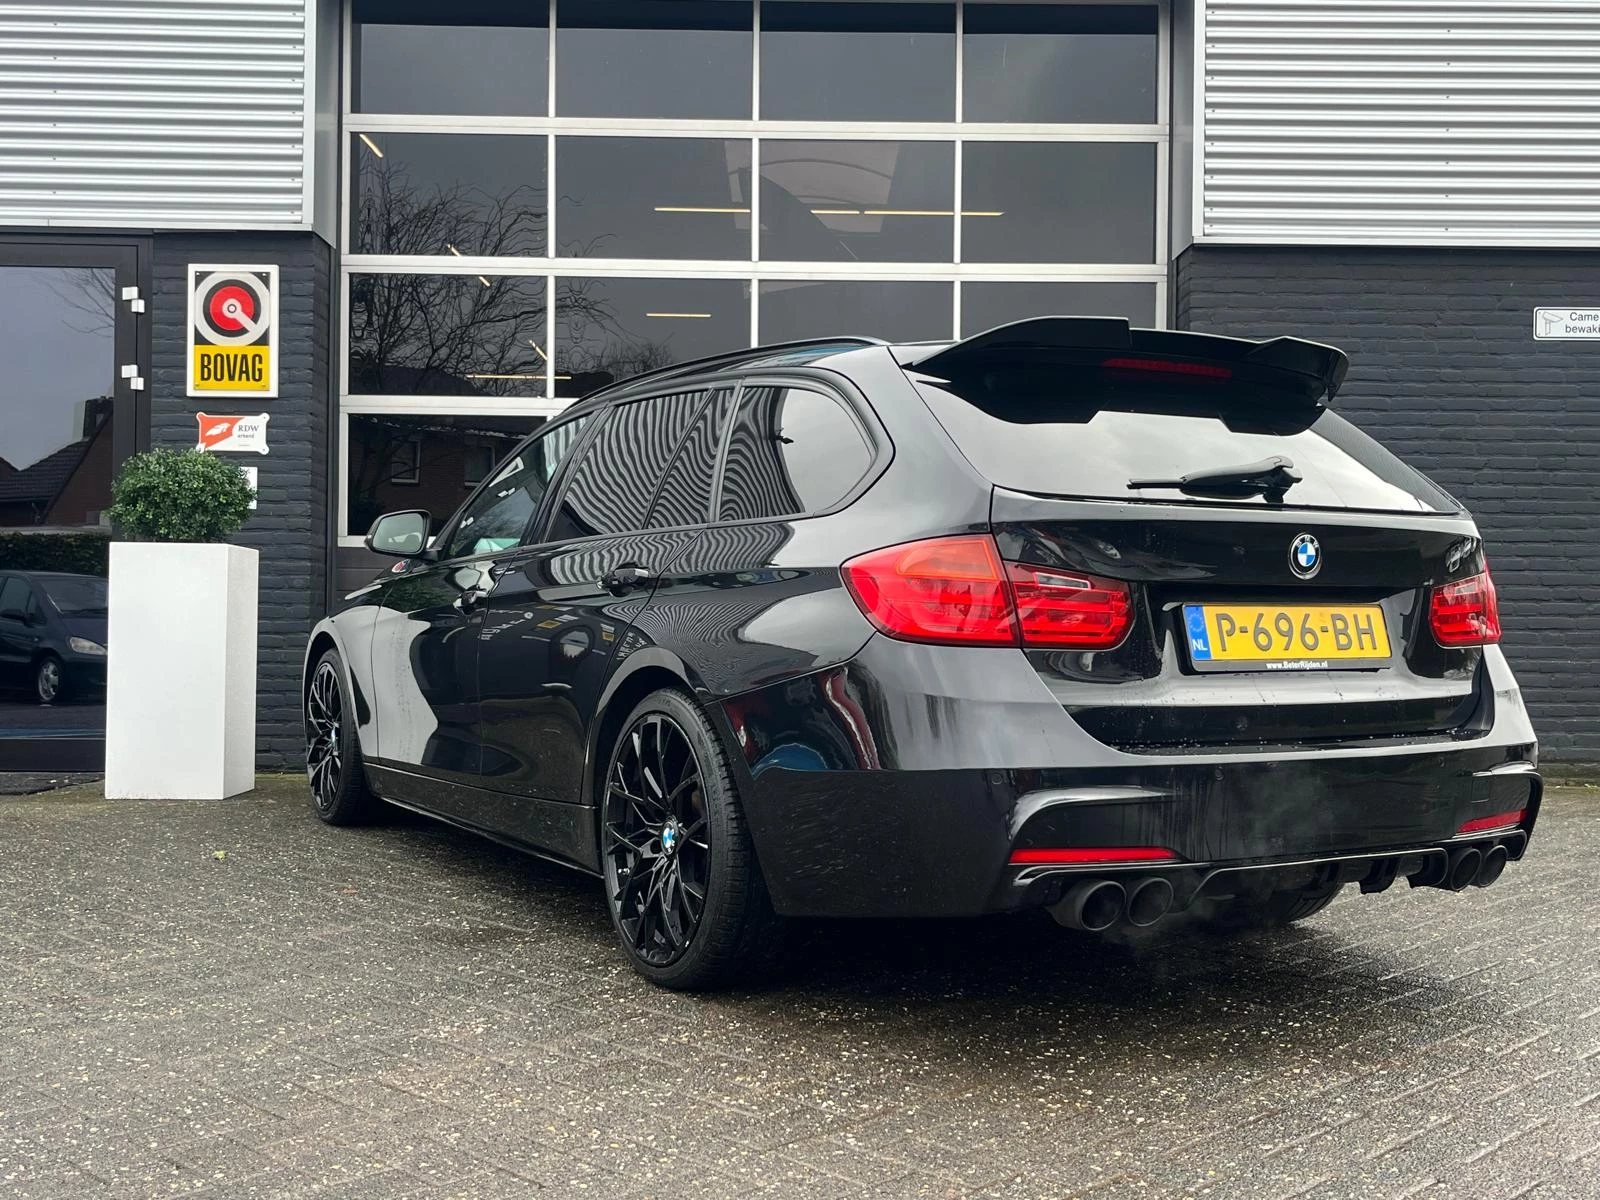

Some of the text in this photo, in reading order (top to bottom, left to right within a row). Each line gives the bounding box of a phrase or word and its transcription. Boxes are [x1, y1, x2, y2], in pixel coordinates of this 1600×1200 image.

[1570, 311, 1599, 321] Came
[200, 353, 263, 382] BOVAG
[238, 424, 259, 432] RDW
[1216, 612, 1378, 652] P-696-BH
[1192, 639, 1208, 651] NL
[1265, 660, 1329, 670] www.BeterRijden.nl
